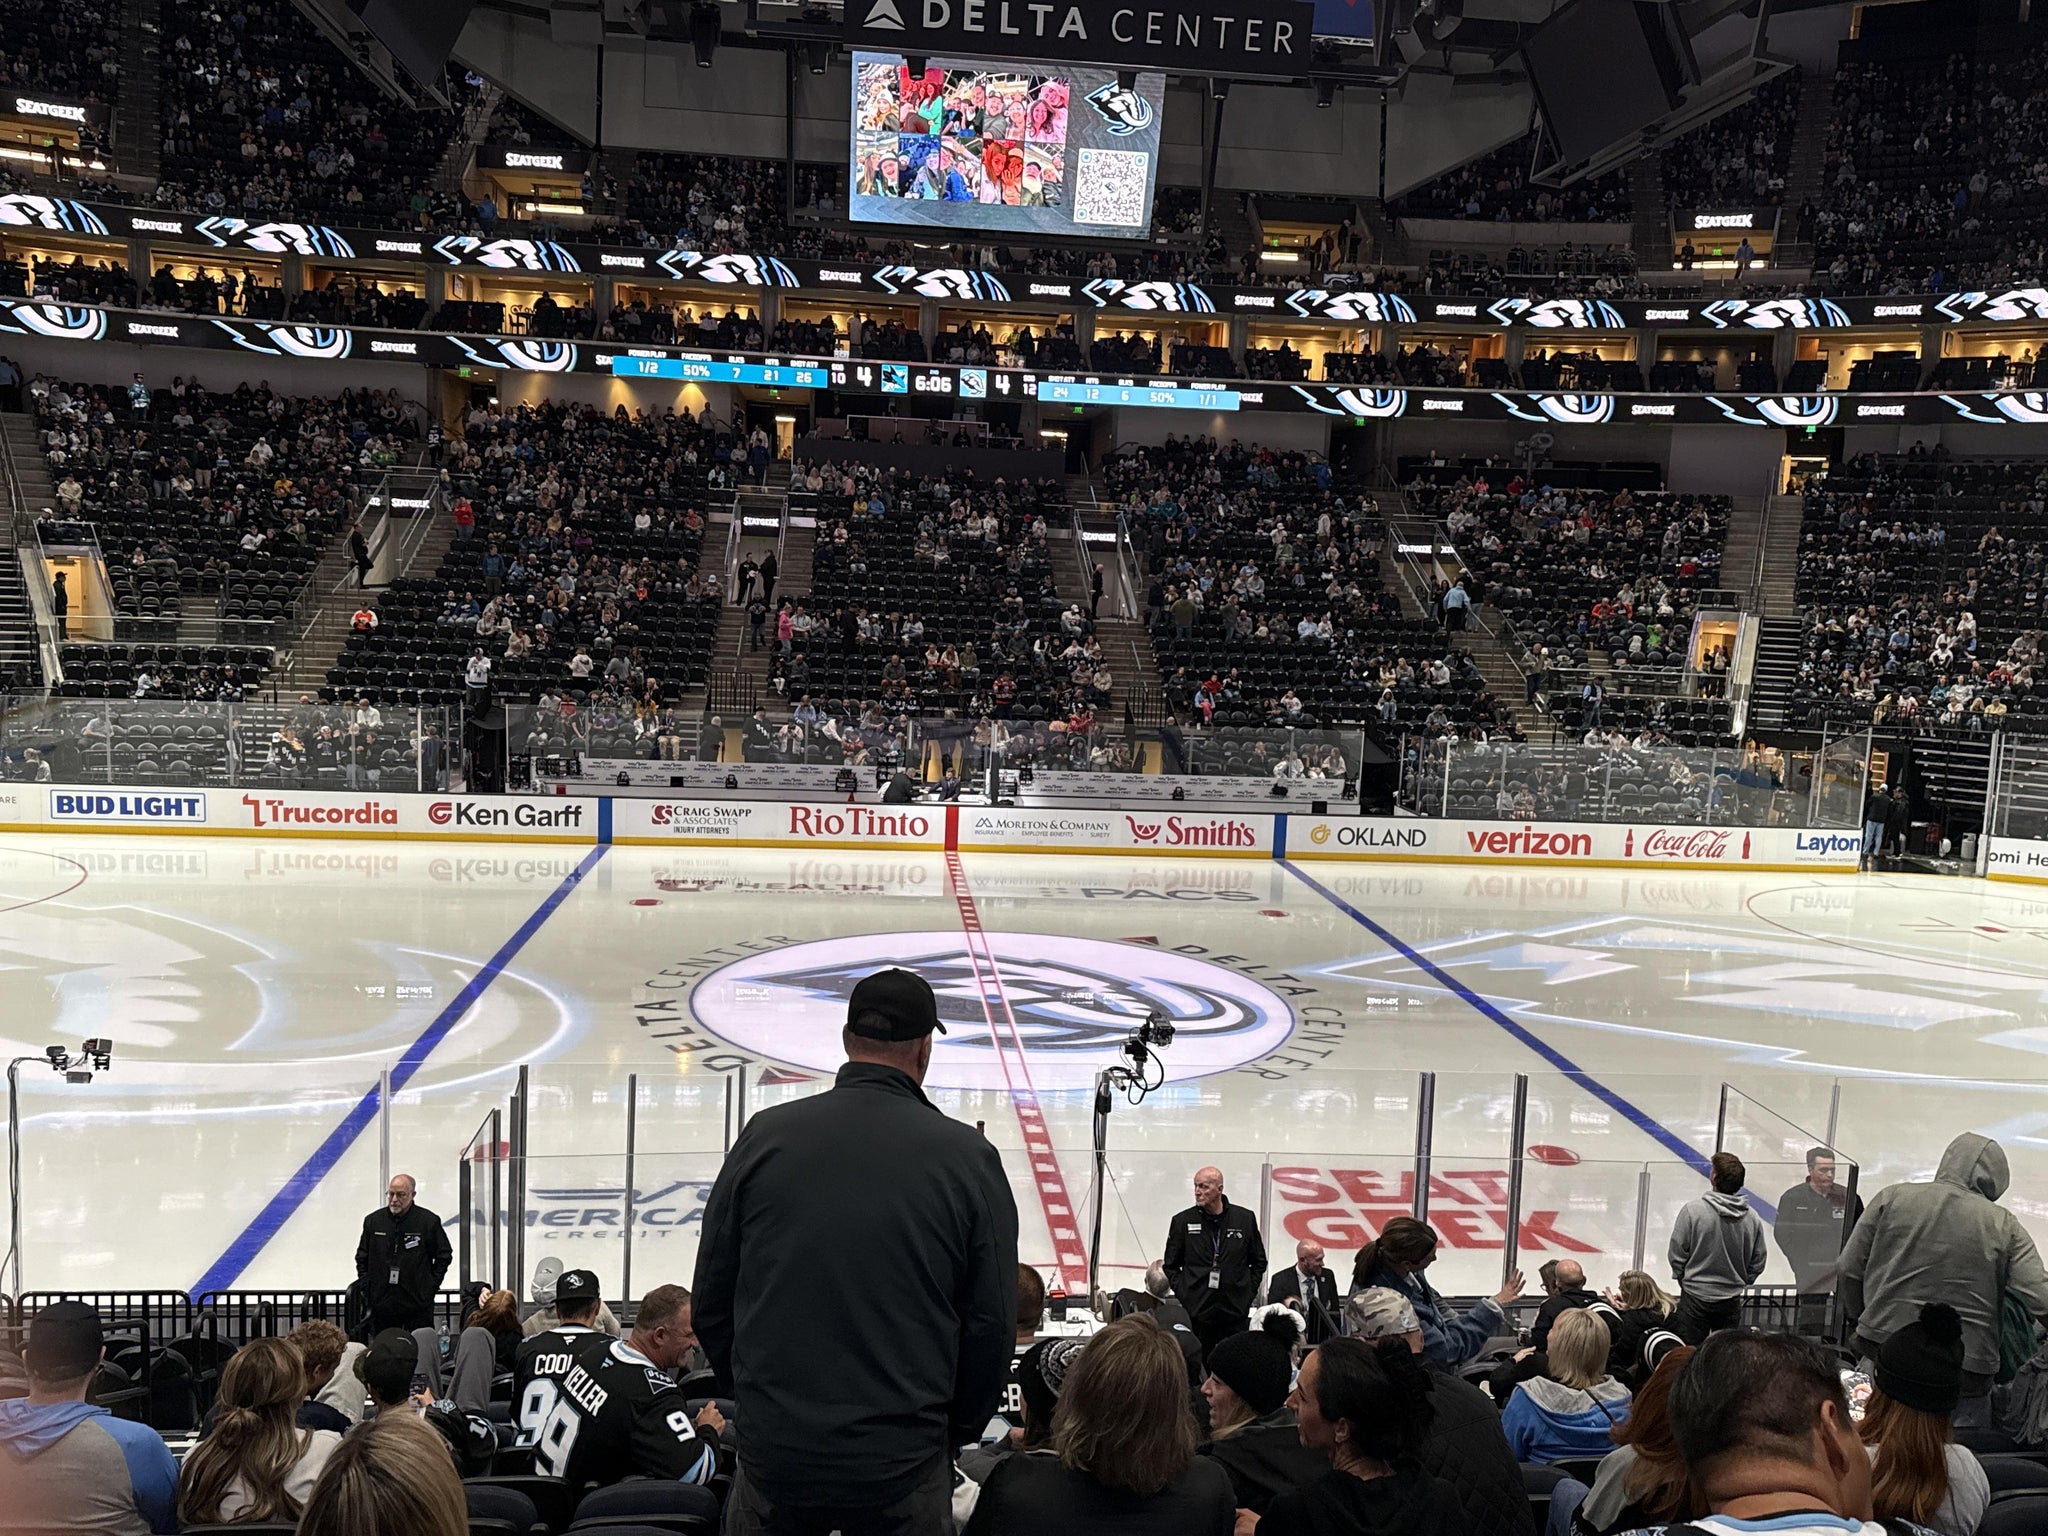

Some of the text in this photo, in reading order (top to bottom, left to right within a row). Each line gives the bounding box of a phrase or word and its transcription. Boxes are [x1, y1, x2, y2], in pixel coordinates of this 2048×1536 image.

[922, 0, 1294, 54] DELTA CENTER
[15, 97, 86, 122] SEATGEEK
[505, 152, 563, 170] SEATGEEK
[131, 218, 182, 234] SEATGEEK
[1694, 213, 1753, 229] SEATGEEK
[375, 239, 422, 254] SEATGEEK
[600, 254, 645, 268] SEATGEEK
[819, 269, 862, 284] SEATGEEK
[1029, 283, 1070, 297] SEATGEEK
[1234, 295, 1275, 307] SEATGEEK
[1435, 304, 1477, 317] SEATGEEK
[1645, 309, 1689, 321] SEATGEEK
[1873, 304, 1922, 317] SEATGEEK
[128, 322, 179, 338] SEATGEEK
[370, 340, 417, 354] SEATGEEK
[638, 361, 659, 374] 1/2
[683, 364, 711, 376] 50%
[732, 367, 741, 379] 7
[764, 369, 779, 381] 21
[796, 371, 812, 383] 26
[831, 372, 847, 384] 10
[857, 366, 873, 387] 4
[915, 375, 952, 392] 6:06
[995, 374, 1011, 394] 4
[1023, 383, 1037, 395] 12
[1053, 387, 1069, 398] 24
[1086, 388, 1099, 400] 12
[1121, 390, 1130, 401] 6
[1150, 392, 1175, 403] 50%
[1200, 394, 1217, 405] 1/1
[1422, 399, 1464, 411] SEATGEEK
[1631, 404, 1675, 416] SEATGEEK
[1857, 404, 1905, 417] SEATGEEK
[0, 796, 17, 804] ARE
[56, 795, 200, 817] BUD LIGHT
[266, 800, 398, 825] Trucordia
[456, 802, 582, 827] Ken Garff
[674, 805, 752, 818] CRAIG SWAPP
[674, 817, 738, 826] & ASSOCIATES
[789, 806, 929, 837] Rio Tinto
[996, 819, 1110, 831] MORETON & COMPANY
[673, 826, 730, 835] INJURY ATTORNEYS
[1166, 816, 1255, 847] Smith's
[1337, 827, 1427, 847] OKLAND
[1468, 826, 1592, 855] verizon
[1644, 829, 1733, 859] Coca-Cola
[1796, 832, 1861, 855] Layton
[1990, 852, 2048, 868] omi He
[735, 882, 886, 891] HEALTH
[1081, 888, 1260, 901] PACS
[645, 935, 804, 989] CENTER
[1170, 944, 1347, 1080] DELTA CENTER
[634, 1000, 755, 1073] DELTA
[1271, 1166, 1510, 1206] SEAT
[563, 1364, 609, 1417] KELLER
[665, 1410, 696, 1443] 9
